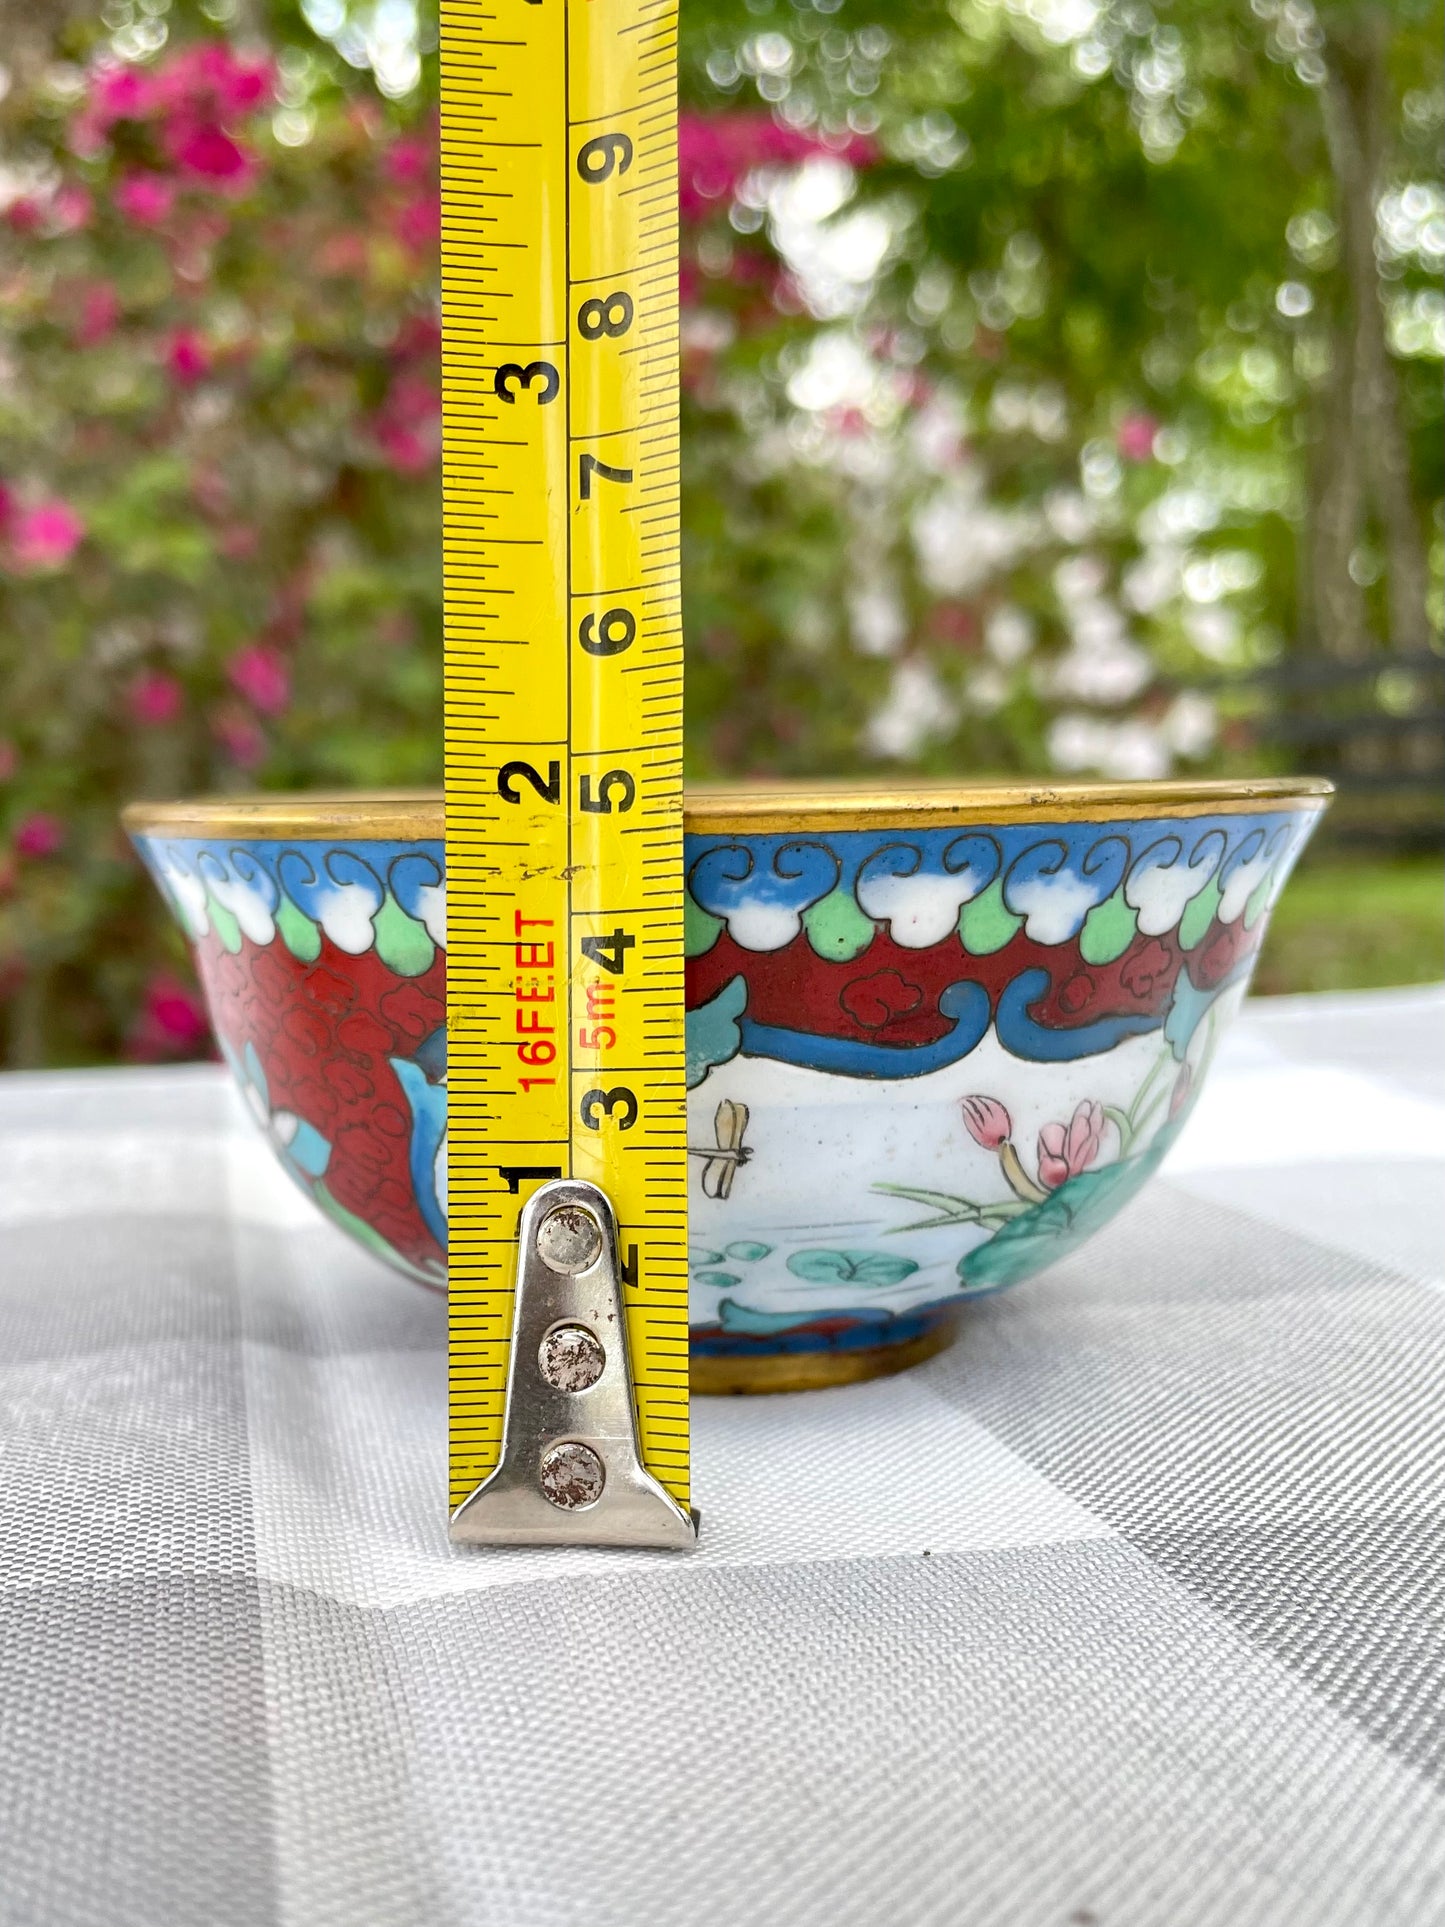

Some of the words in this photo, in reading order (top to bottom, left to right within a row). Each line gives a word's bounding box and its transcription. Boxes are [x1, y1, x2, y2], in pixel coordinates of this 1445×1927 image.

[577, 133, 633, 184] 9
[578, 291, 633, 340] 8
[495, 362, 560, 405] 3
[580, 454, 633, 499] 7
[579, 608, 636, 656] 6
[498, 760, 560, 804] 2
[580, 769, 635, 814] 5
[581, 928, 635, 975] 4
[579, 983, 616, 1050] 5m
[581, 1086, 637, 1131] 3
[500, 1166, 561, 1193] 1
